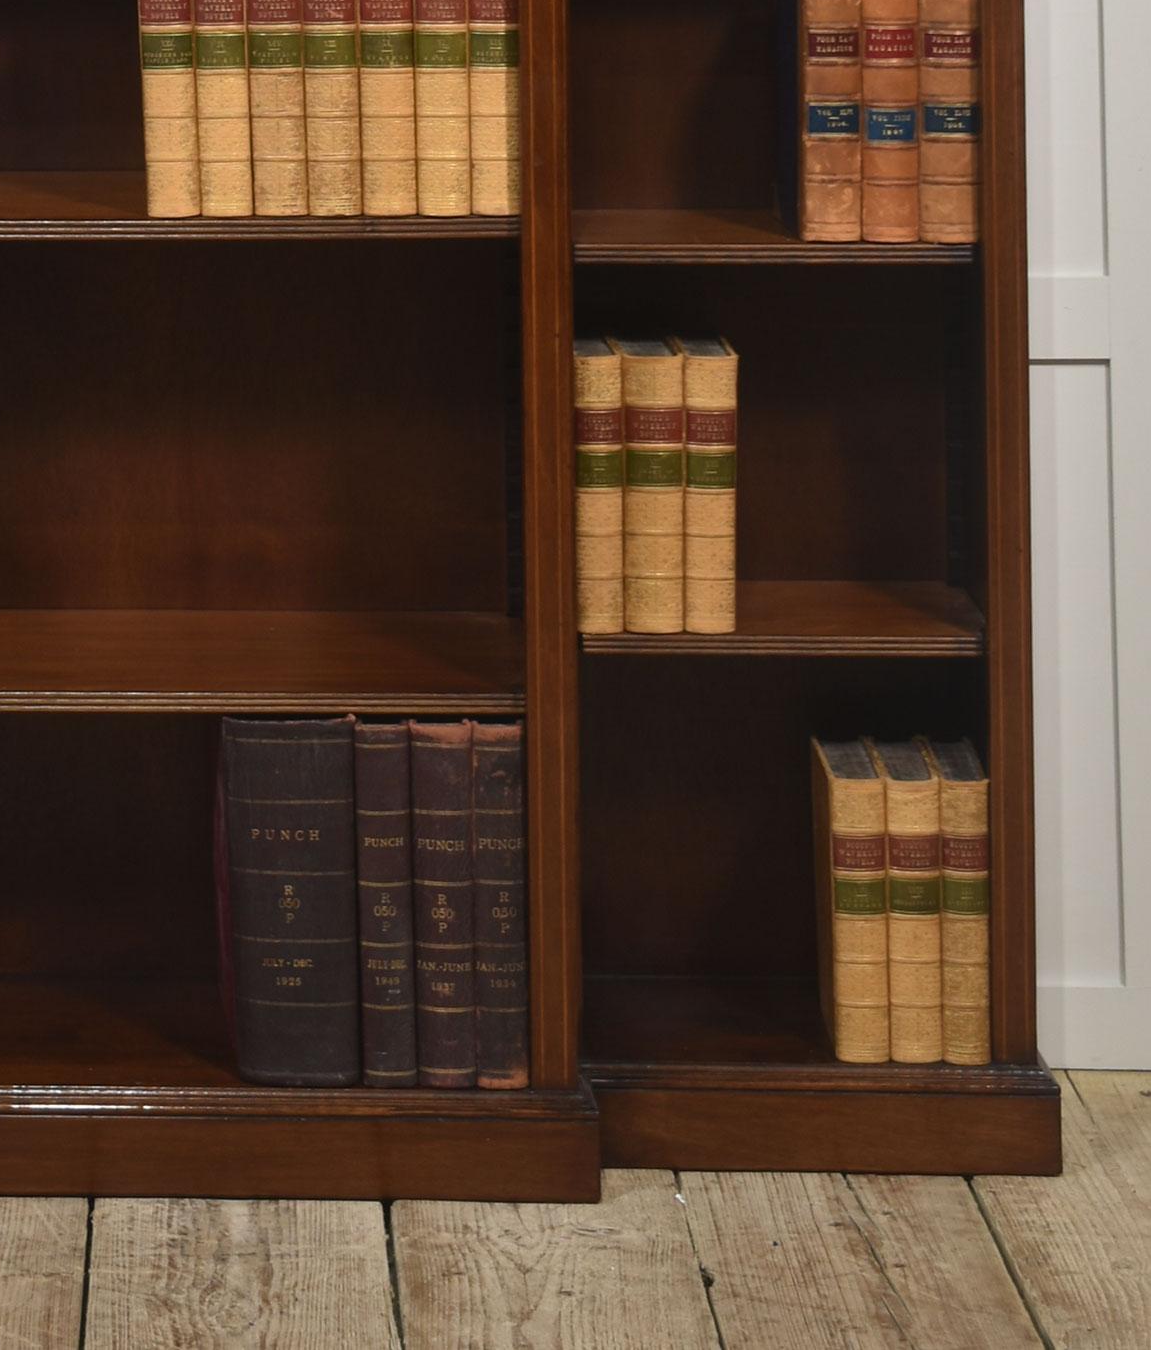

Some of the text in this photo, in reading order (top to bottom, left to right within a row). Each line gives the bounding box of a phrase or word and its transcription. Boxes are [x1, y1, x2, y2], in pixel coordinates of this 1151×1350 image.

[250, 828, 321, 841] PUNCH
[363, 837, 405, 848] PUNCH
[417, 838, 465, 852] PUNCH
[283, 884, 294, 896] R
[380, 892, 392, 904] R
[437, 893, 448, 906] R
[499, 891, 510, 903] R
[285, 912, 295, 924] P
[381, 921, 392, 932] P
[438, 922, 448, 934] P
[500, 922, 510, 934] P
